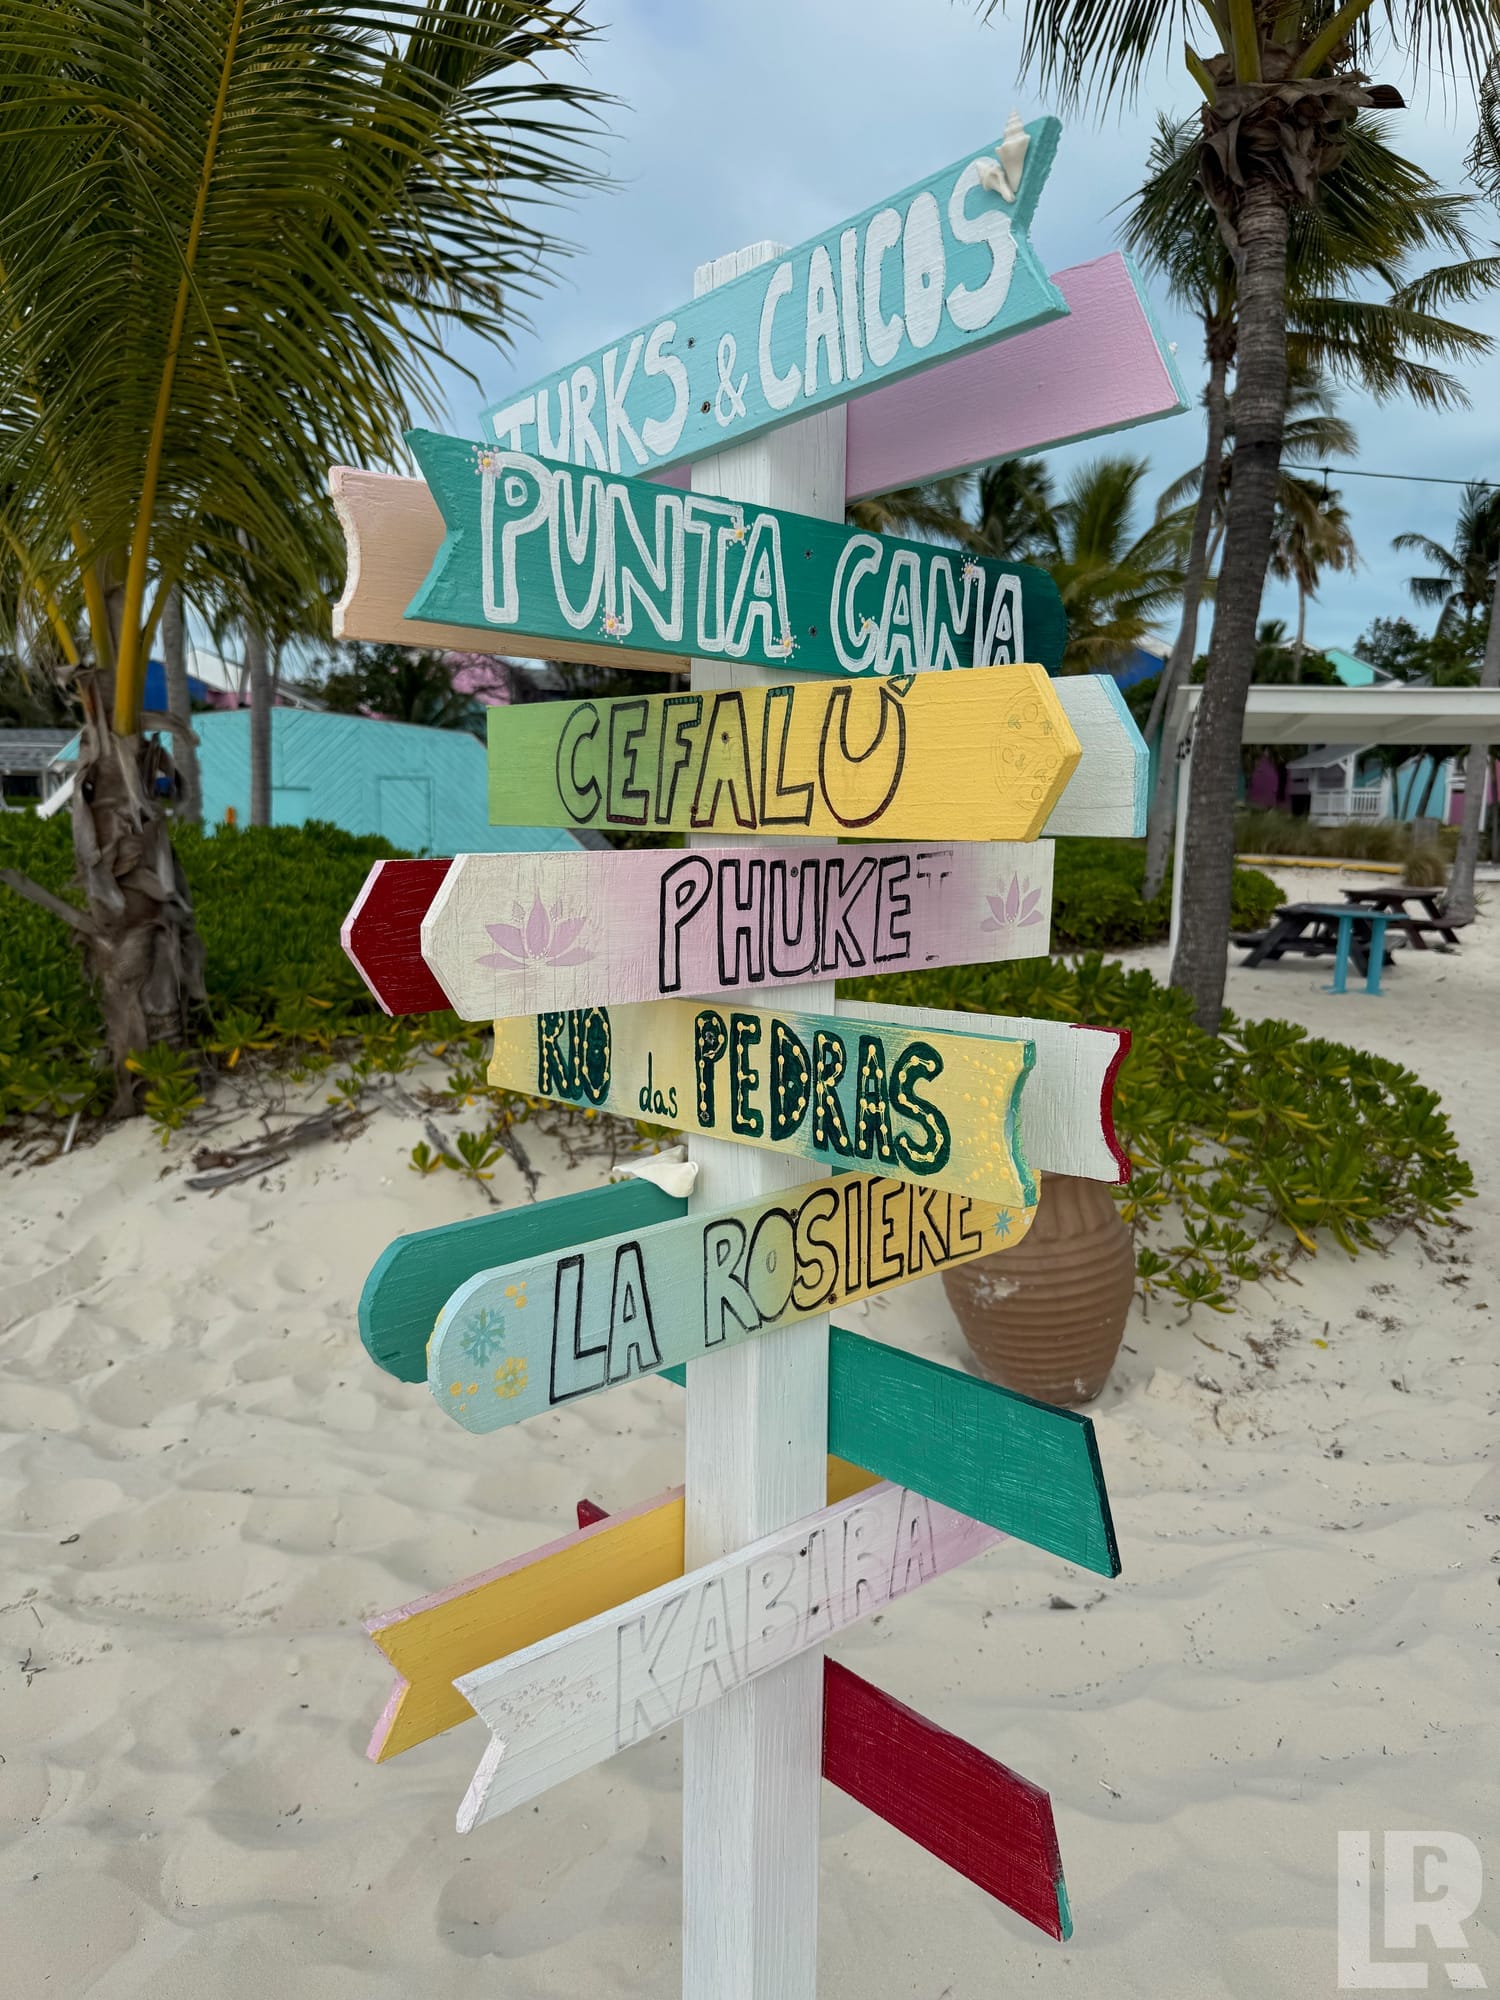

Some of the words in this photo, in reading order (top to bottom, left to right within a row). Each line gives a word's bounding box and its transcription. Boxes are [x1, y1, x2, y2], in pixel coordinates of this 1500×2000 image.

[492, 320, 690, 474] TURKS
[714, 333, 749, 428] &
[758, 156, 1018, 412] CAICOS
[480, 452, 790, 659] PUNTA
[830, 534, 1024, 676] CANA
[658, 850, 953, 994] PHUKET
[537, 1007, 612, 1106] RIO
[639, 1051, 679, 1119] das
[694, 1010, 952, 1175] PEDRAS
[549, 1241, 664, 1405] LA
[615, 1488, 938, 1753] KABIRA
